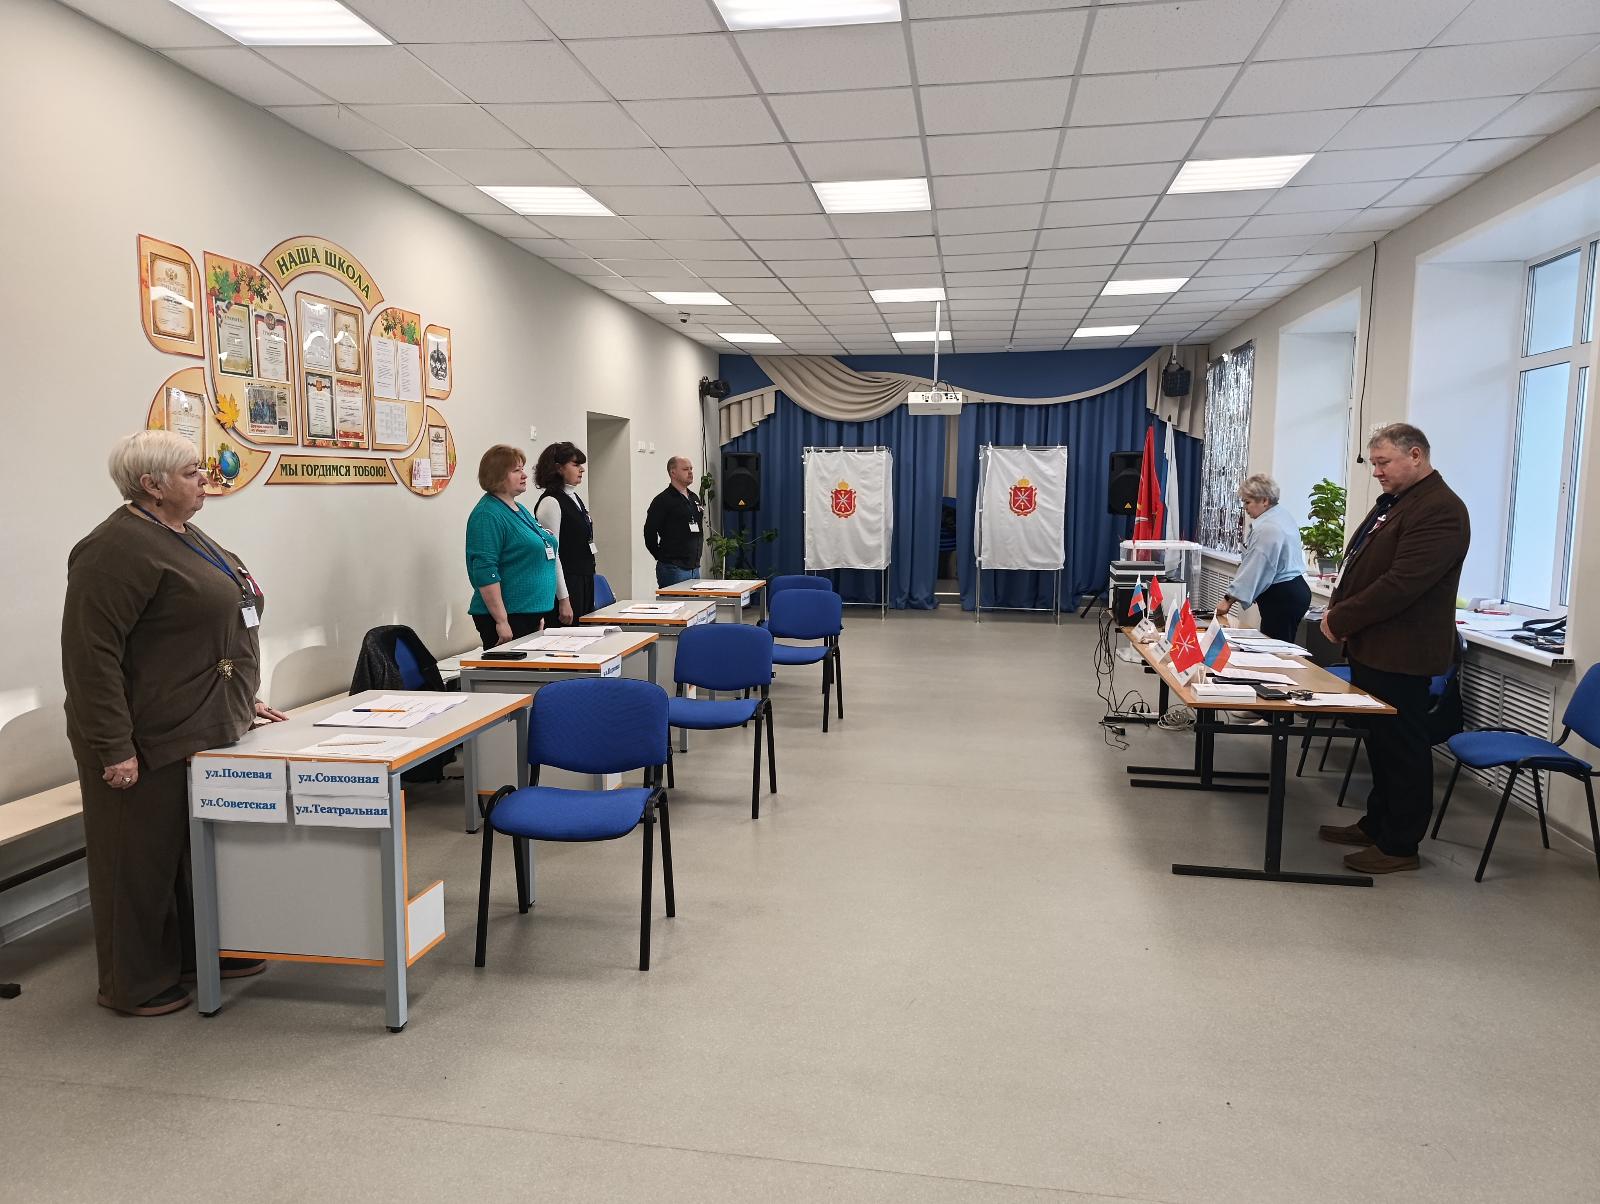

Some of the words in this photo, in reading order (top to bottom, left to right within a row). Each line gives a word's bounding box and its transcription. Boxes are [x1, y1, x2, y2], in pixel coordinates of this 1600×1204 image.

[276, 247, 321, 276] НАША
[324, 249, 371, 300] ШКОЛА
[280, 463, 298, 477] МЫ
[301, 464, 351, 479] ГОРДИМСЯ
[353, 465, 387, 477] ТОБОЮ!
[205, 768, 272, 780] ул.Полевая
[298, 772, 380, 784] ул.Совхозная
[200, 797, 276, 810] ул.Советская
[295, 804, 389, 817] ул.Театральная
